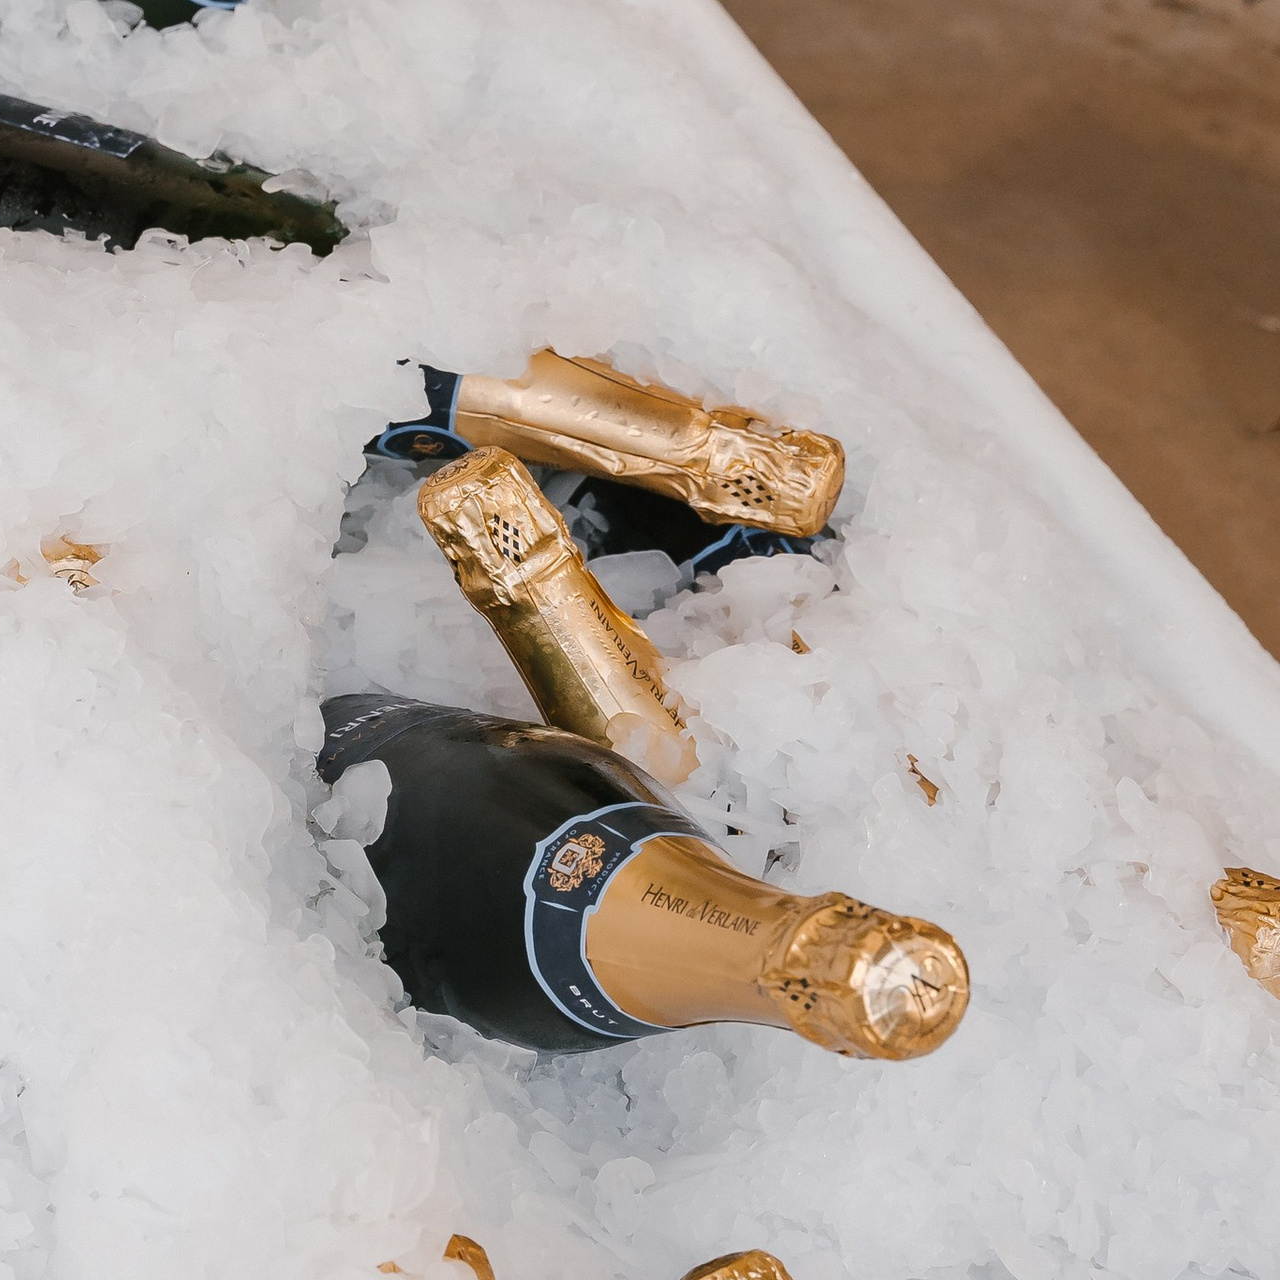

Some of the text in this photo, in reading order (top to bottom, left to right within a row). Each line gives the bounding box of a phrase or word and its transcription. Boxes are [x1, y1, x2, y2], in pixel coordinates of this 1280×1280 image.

[589, 599, 638, 677] VERLAINE
[650, 684, 686, 729] HERI
[539, 840, 561, 880] FRANCE
[641, 883, 689, 915] HENRI
[699, 901, 761, 936] VERLAINE
[569, 985, 619, 1025] BRUT
